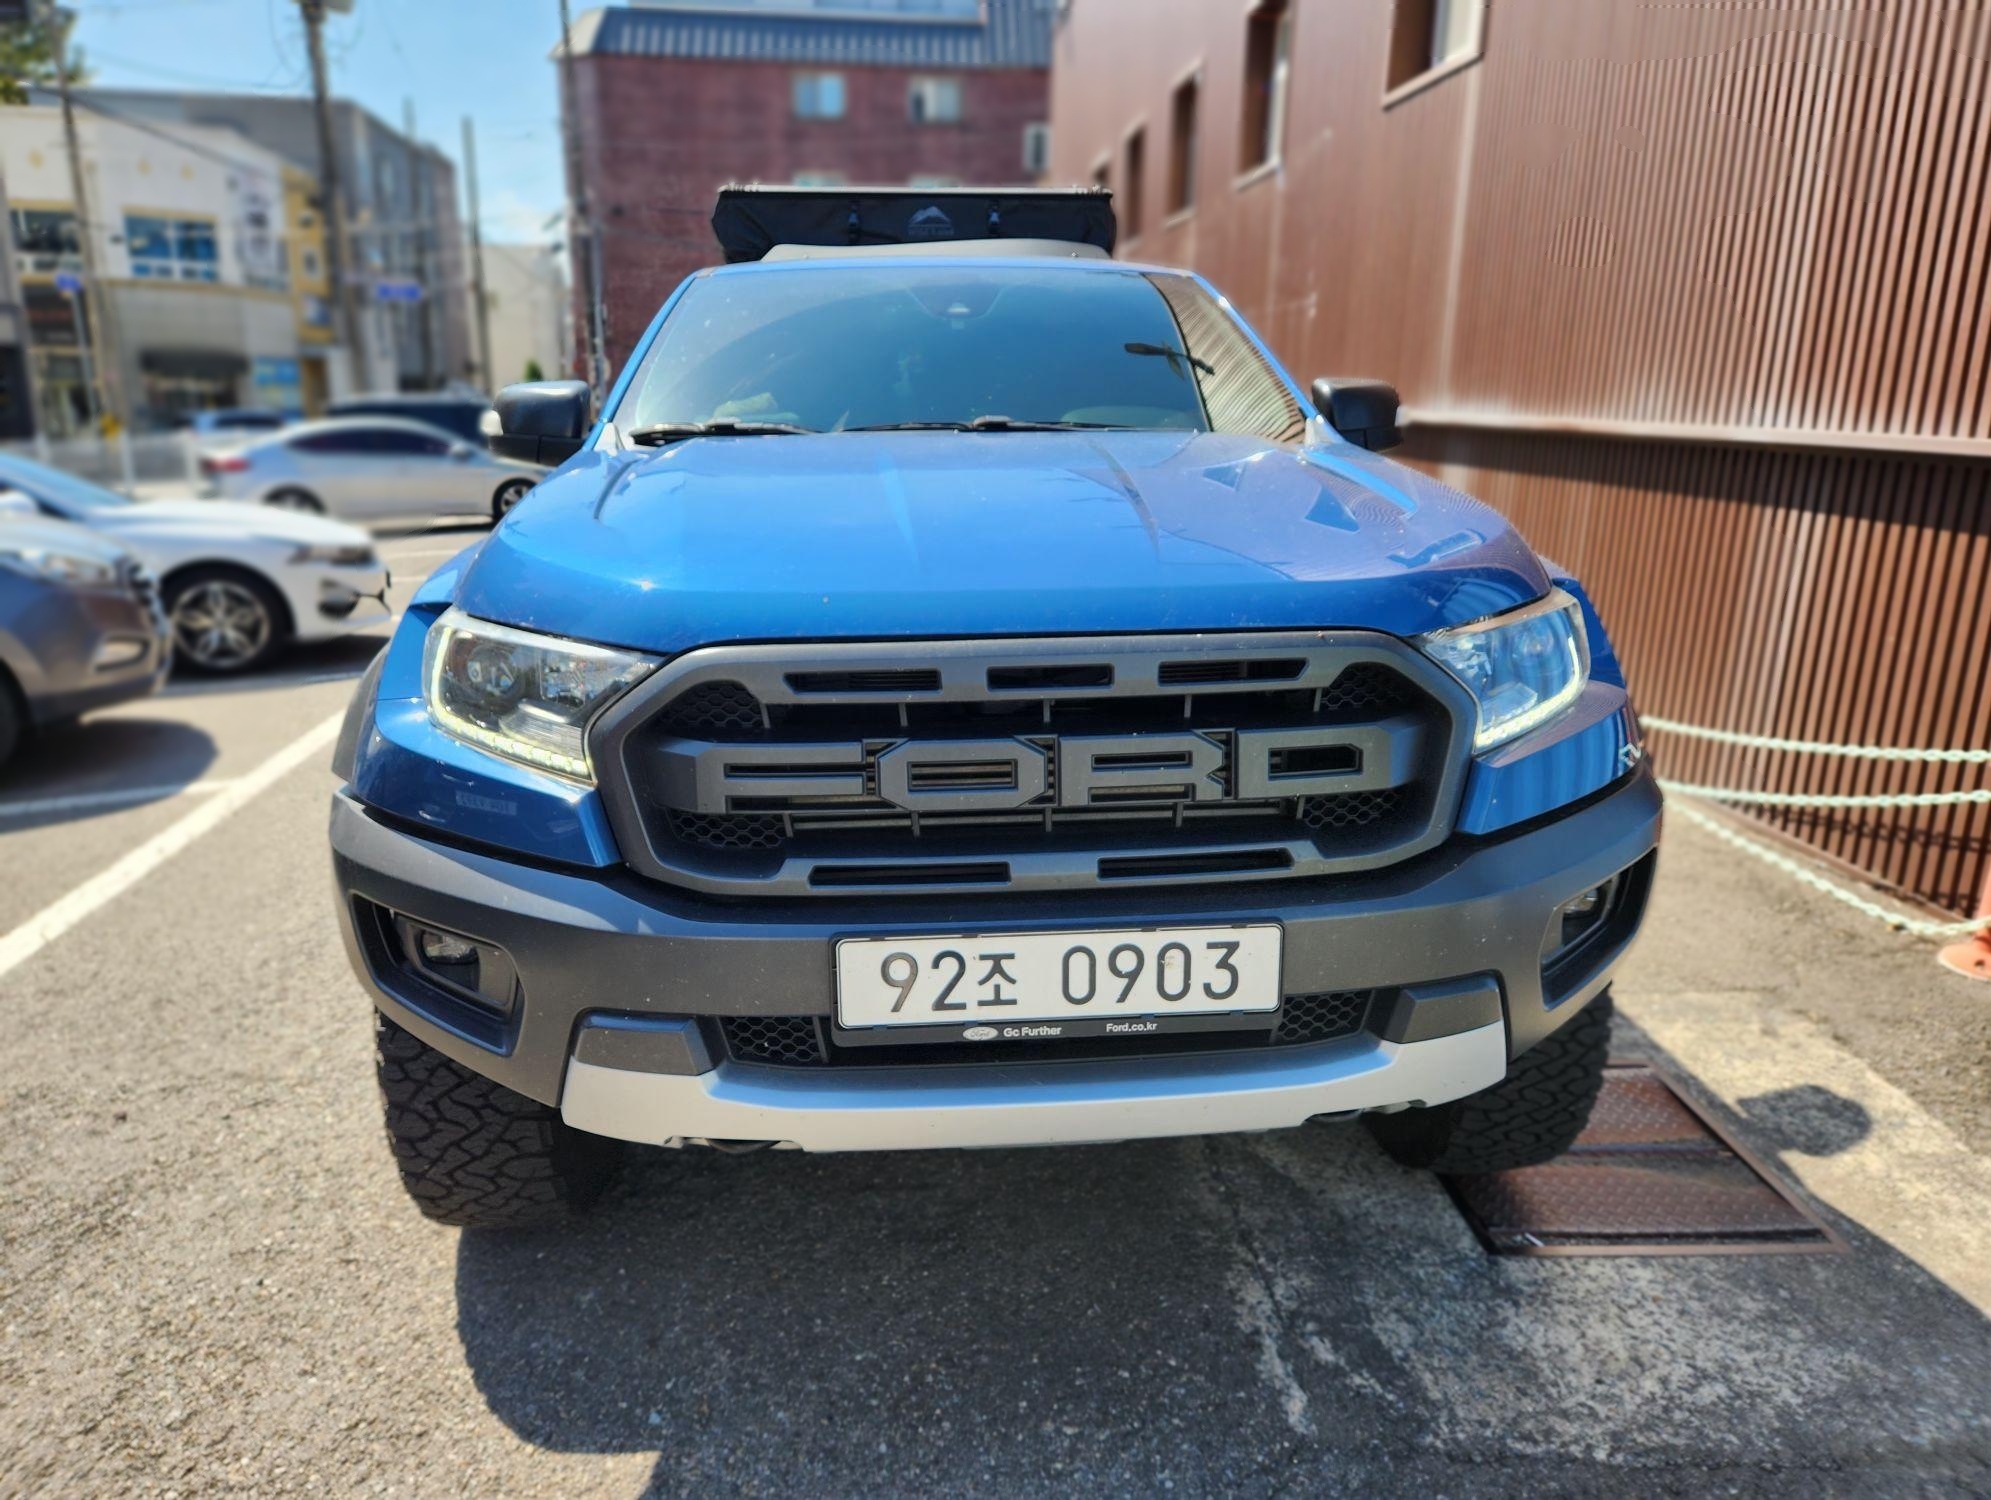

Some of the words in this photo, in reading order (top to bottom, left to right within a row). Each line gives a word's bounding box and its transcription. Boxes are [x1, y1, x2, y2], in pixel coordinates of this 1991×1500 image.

[694, 725, 1398, 815] FORD
[880, 950, 1018, 1012] 92조
[1061, 941, 1241, 1005] 0903
[1003, 1027, 1020, 1037] Go
[1021, 1026, 1062, 1036] Further
[1106, 1022, 1158, 1032] Ford.co.kr
